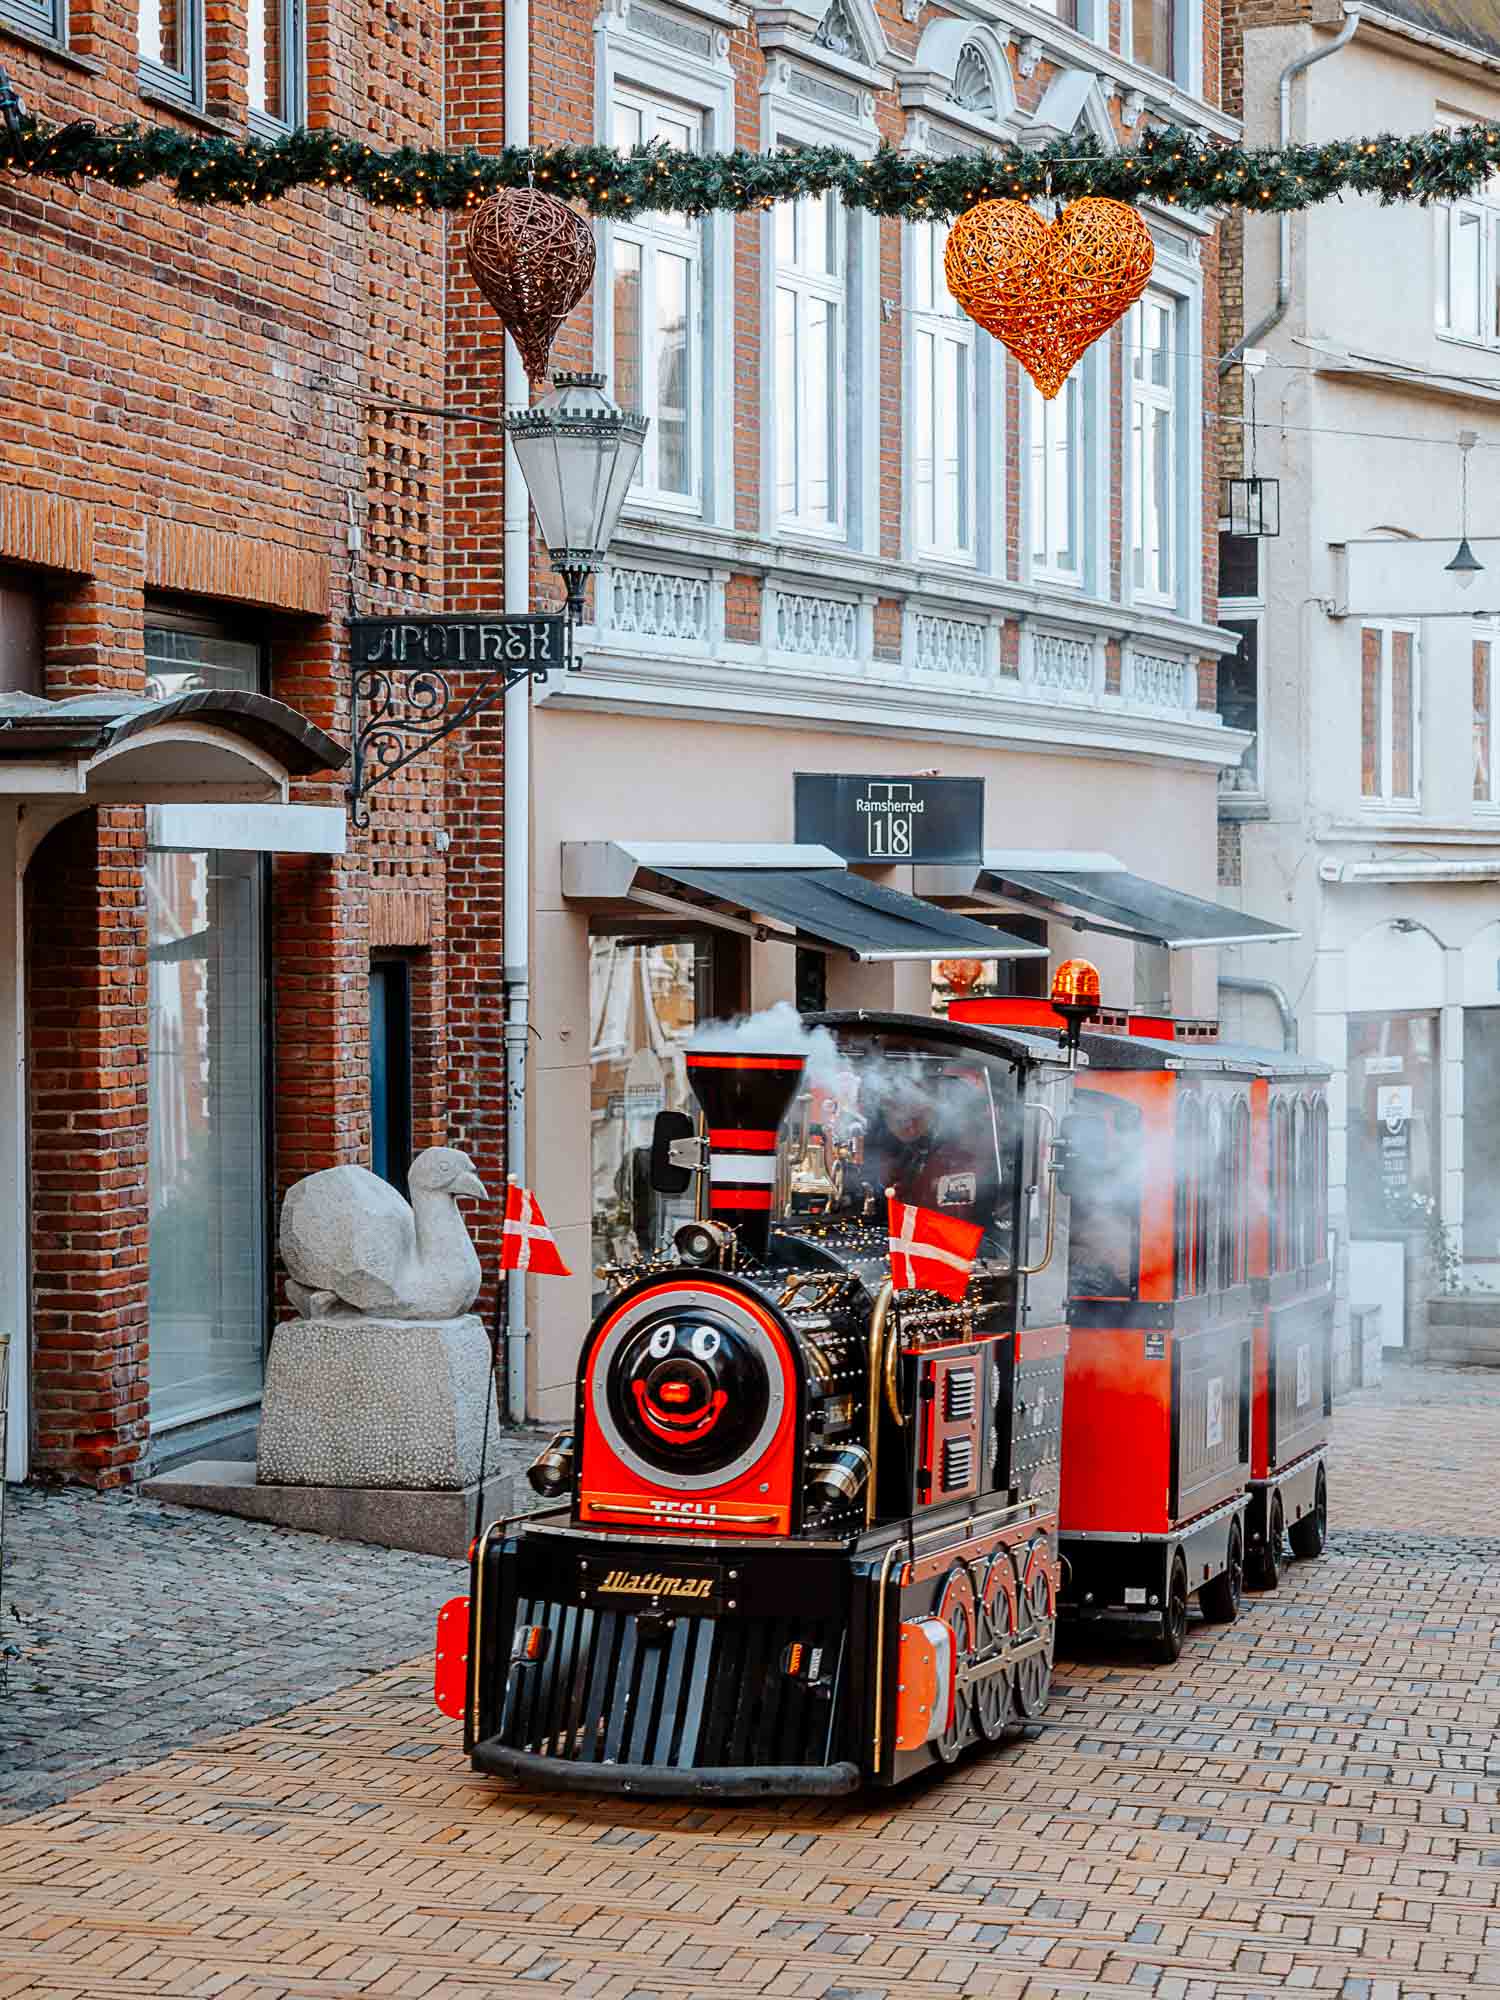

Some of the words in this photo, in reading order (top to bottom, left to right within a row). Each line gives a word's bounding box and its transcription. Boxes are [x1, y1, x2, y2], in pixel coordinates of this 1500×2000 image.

[856, 799, 924, 813] Ramsherred
[872, 819, 909, 854] 18
[598, 1571, 714, 1598] Wattman
